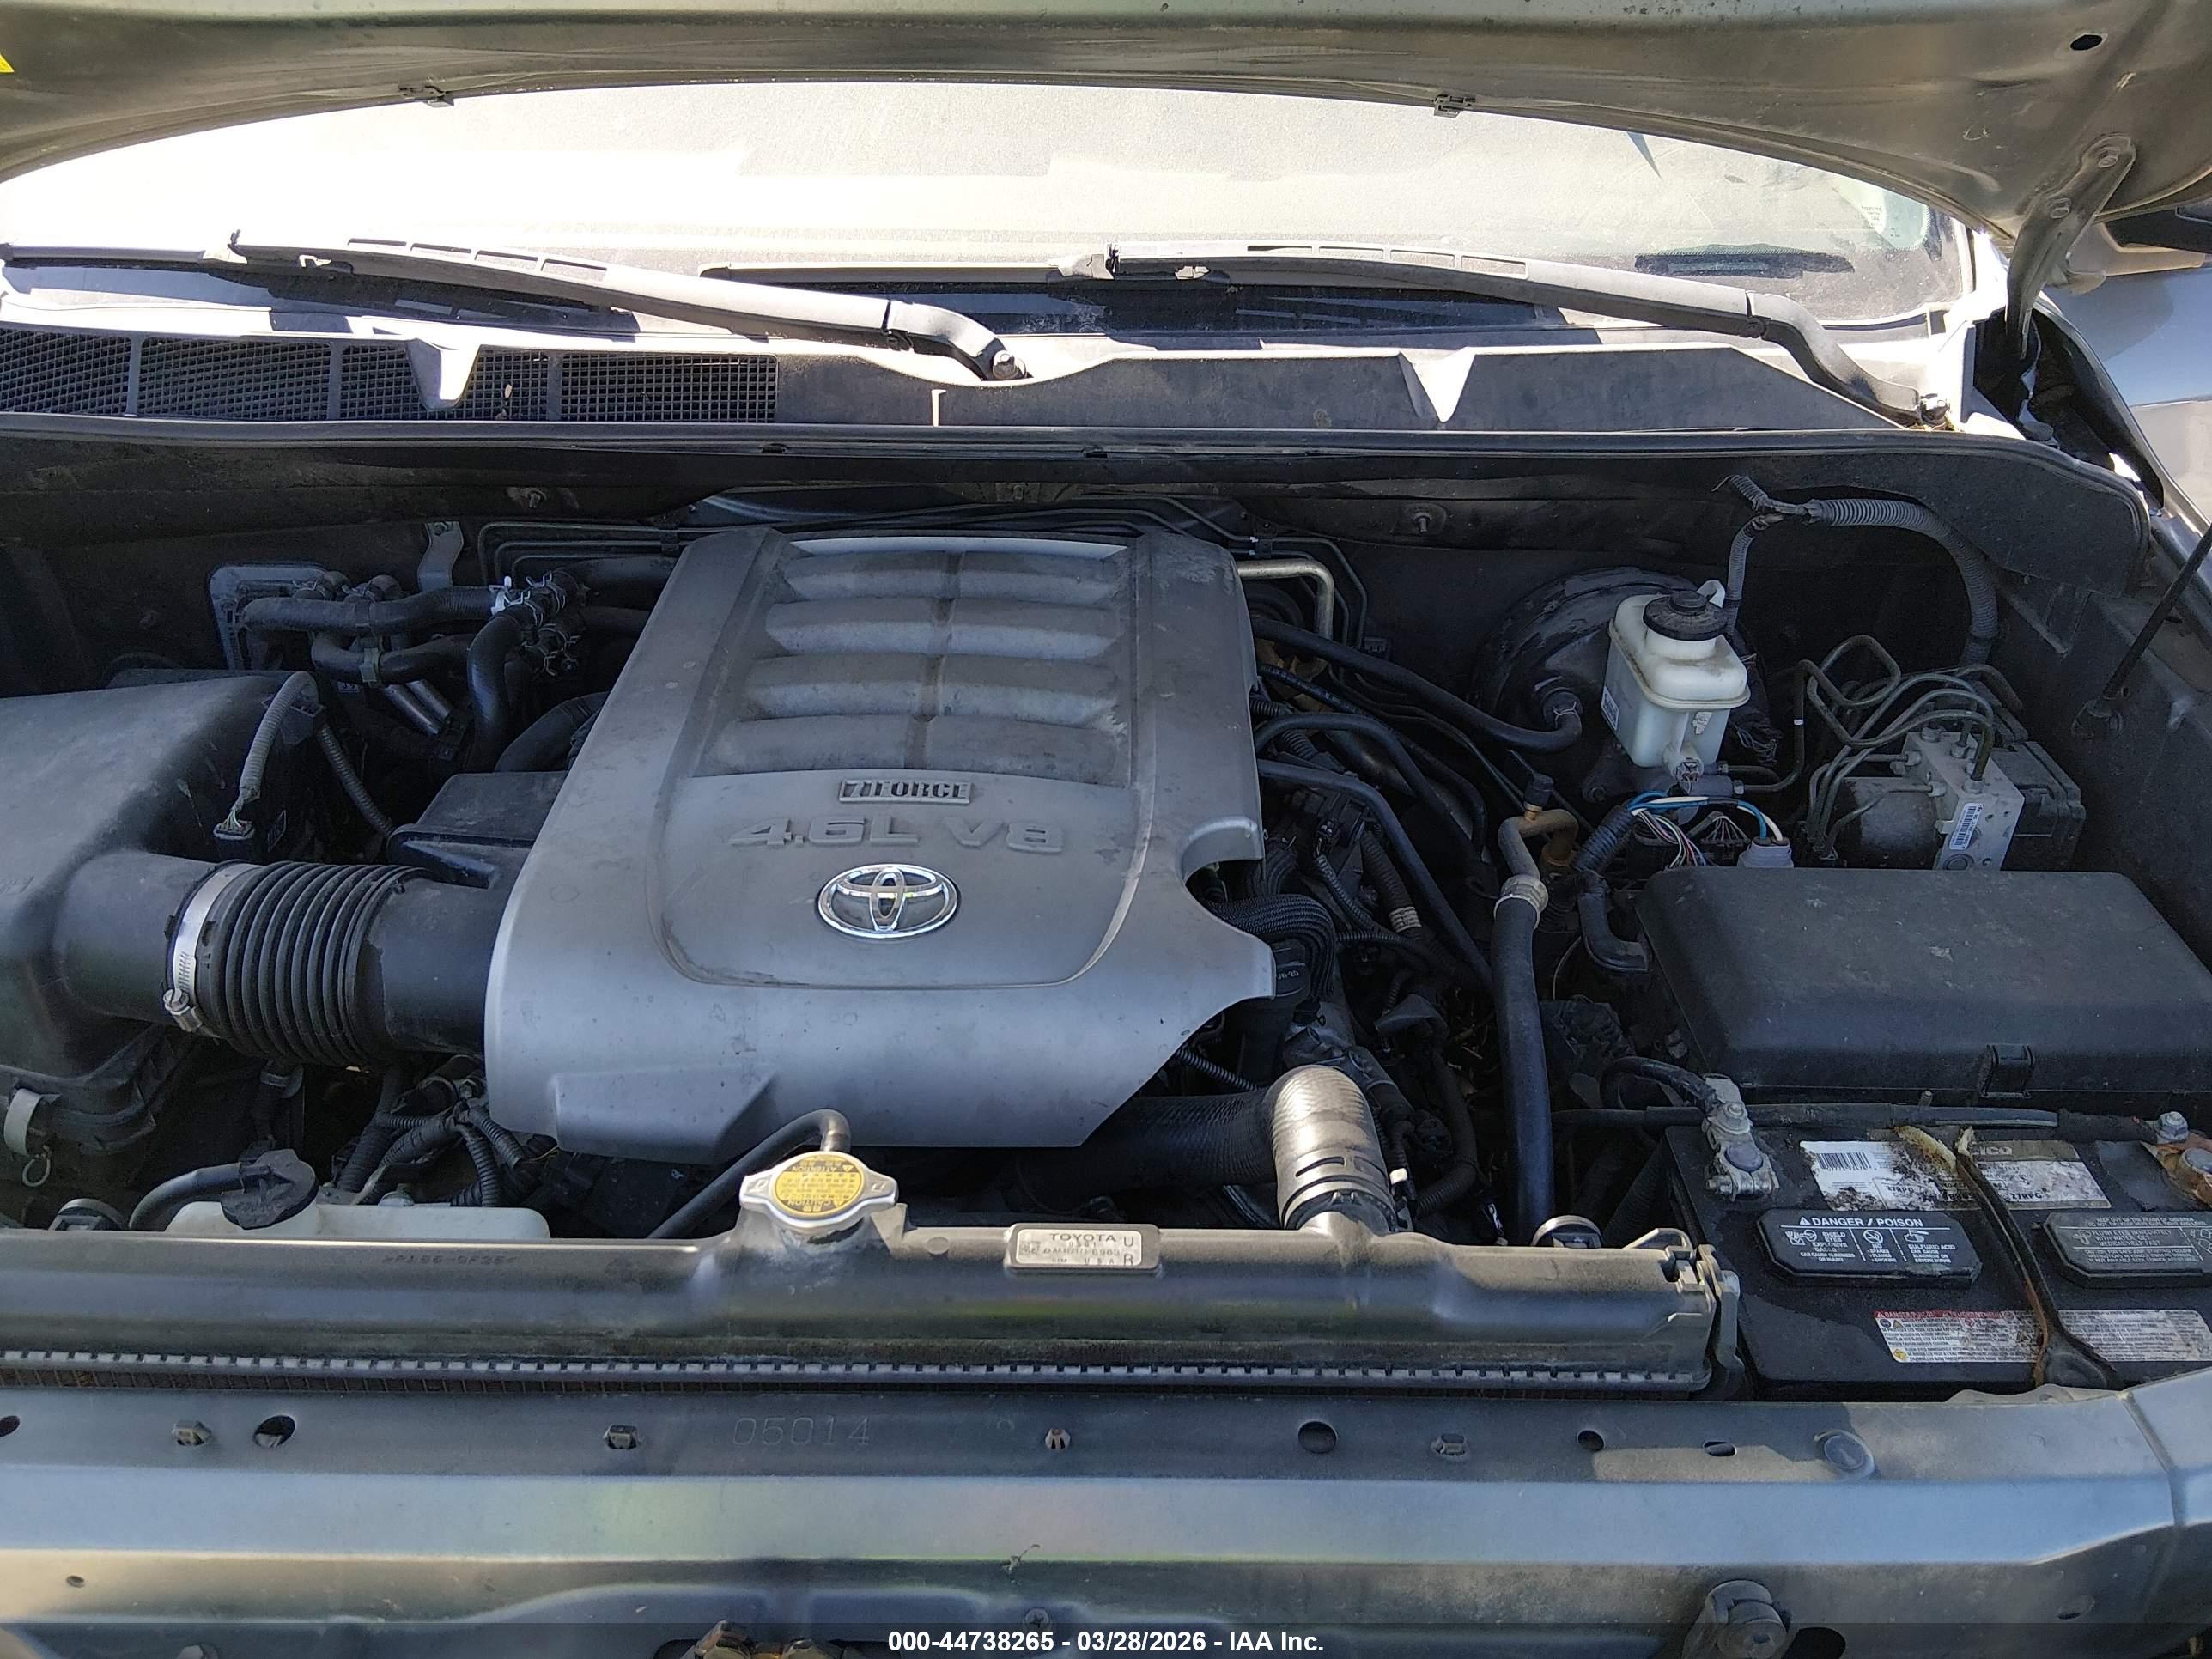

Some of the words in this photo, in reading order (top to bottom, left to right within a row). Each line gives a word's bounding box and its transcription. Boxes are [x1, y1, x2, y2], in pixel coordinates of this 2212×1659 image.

[728, 816, 920, 847] 4.6L
[944, 817, 1065, 853] V8
[1811, 1218, 1864, 1226] DANGER
[1876, 1218, 1923, 1227] POISON
[1049, 1233, 1116, 1243] TOYOTA
[734, 1417, 869, 1445] 05014
